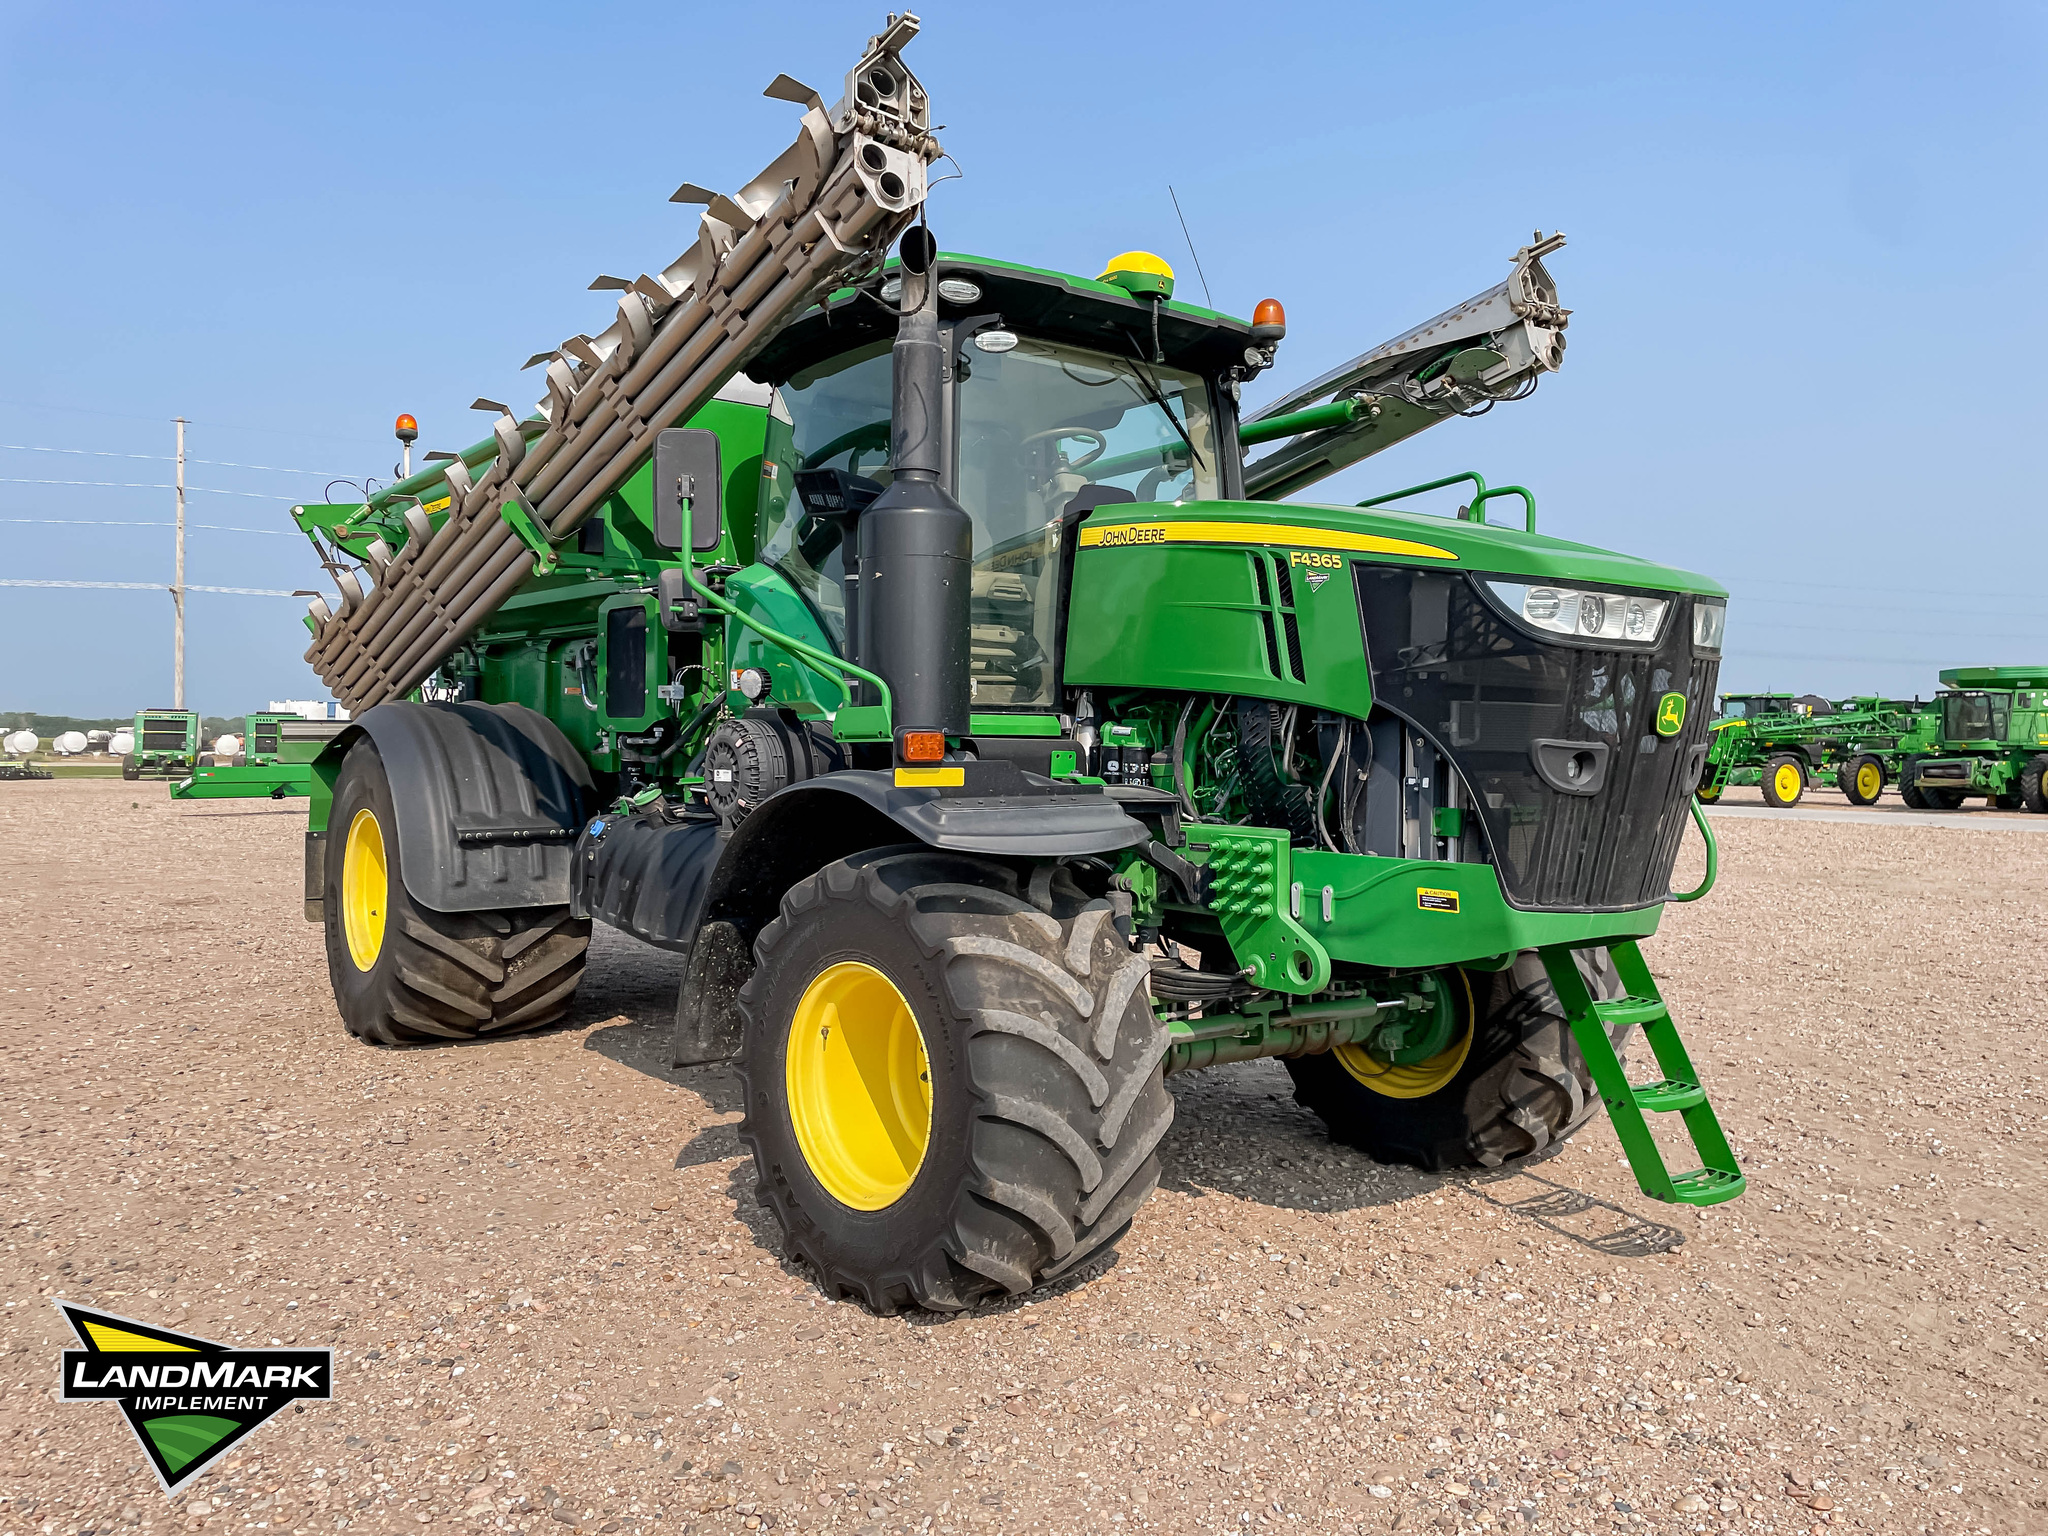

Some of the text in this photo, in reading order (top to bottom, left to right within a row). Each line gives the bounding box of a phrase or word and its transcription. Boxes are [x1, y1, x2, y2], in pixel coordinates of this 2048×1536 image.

[1099, 526, 1166, 545] JOHN DEERE
[1289, 551, 1343, 569] F4365
